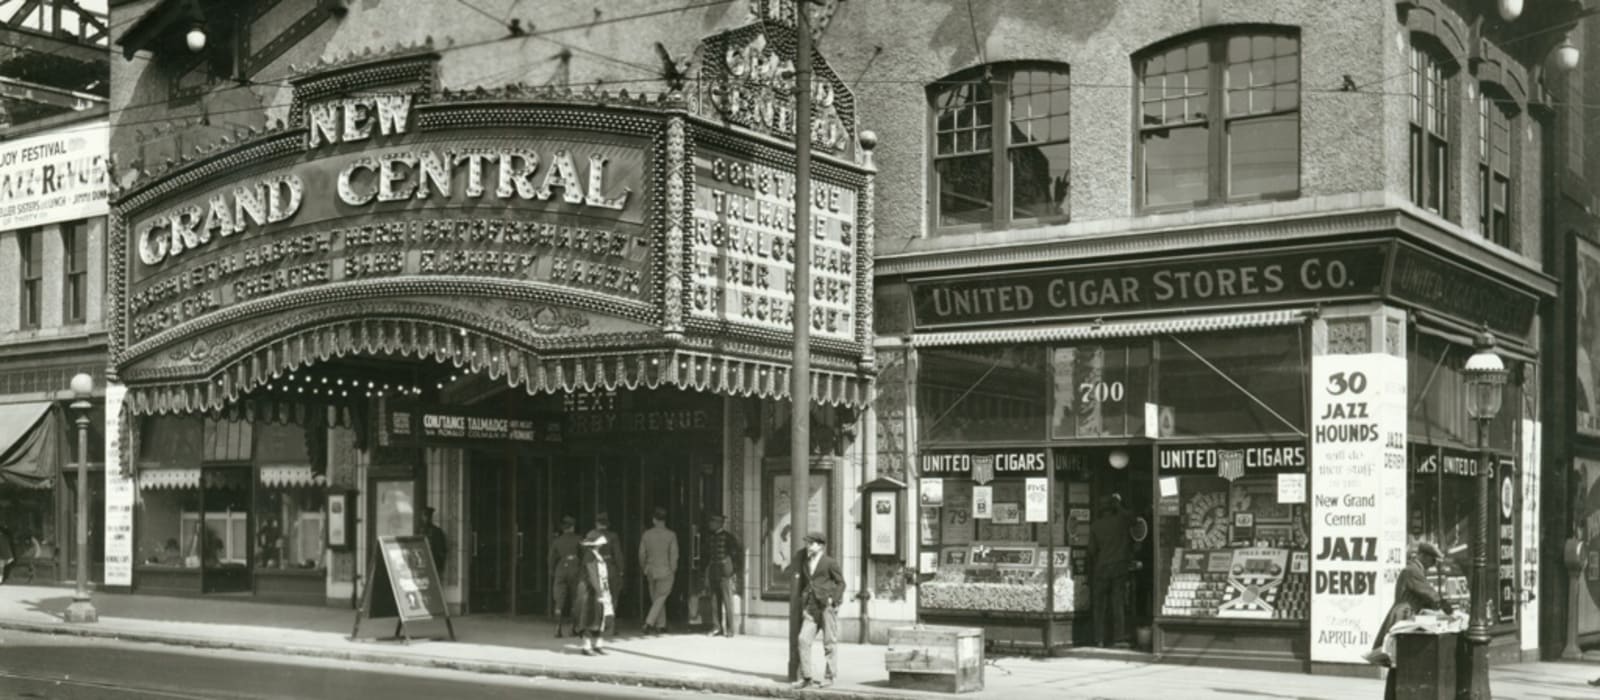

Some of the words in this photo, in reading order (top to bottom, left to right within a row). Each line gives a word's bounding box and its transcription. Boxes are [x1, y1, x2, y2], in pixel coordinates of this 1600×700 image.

[309, 94, 413, 148] NEW
[21, 140, 67, 162] FESTIVAL
[711, 157, 841, 214] CONSTACE
[139, 174, 302, 265] GRAND
[337, 148, 632, 210] CENTRAL
[711, 188, 827, 240] TALMADE
[932, 284, 1034, 317] UNITED
[1047, 277, 1140, 309] CIGAR
[1153, 265, 1285, 301] STORES
[1079, 381, 1124, 402] 700
[1326, 371, 1367, 396] 30
[563, 392, 617, 412] NEXT
[1321, 402, 1369, 420] JAZZ
[468, 417, 508, 432] TALMADGE
[634, 410, 706, 431] REVUE
[1315, 424, 1379, 444] HOUNDS
[922, 454, 970, 472] UNITED
[995, 453, 1045, 471] CIGARS
[1160, 449, 1217, 468] UNITED
[1246, 447, 1305, 467] CIGARS
[1315, 494, 1338, 507] New
[1343, 494, 1375, 508] Grand
[950, 509, 968, 525] 79
[1325, 513, 1366, 526] Central
[1316, 536, 1378, 562] JAZZ
[1315, 570, 1378, 596] DERBY
[1318, 630, 1357, 648] APRIL
